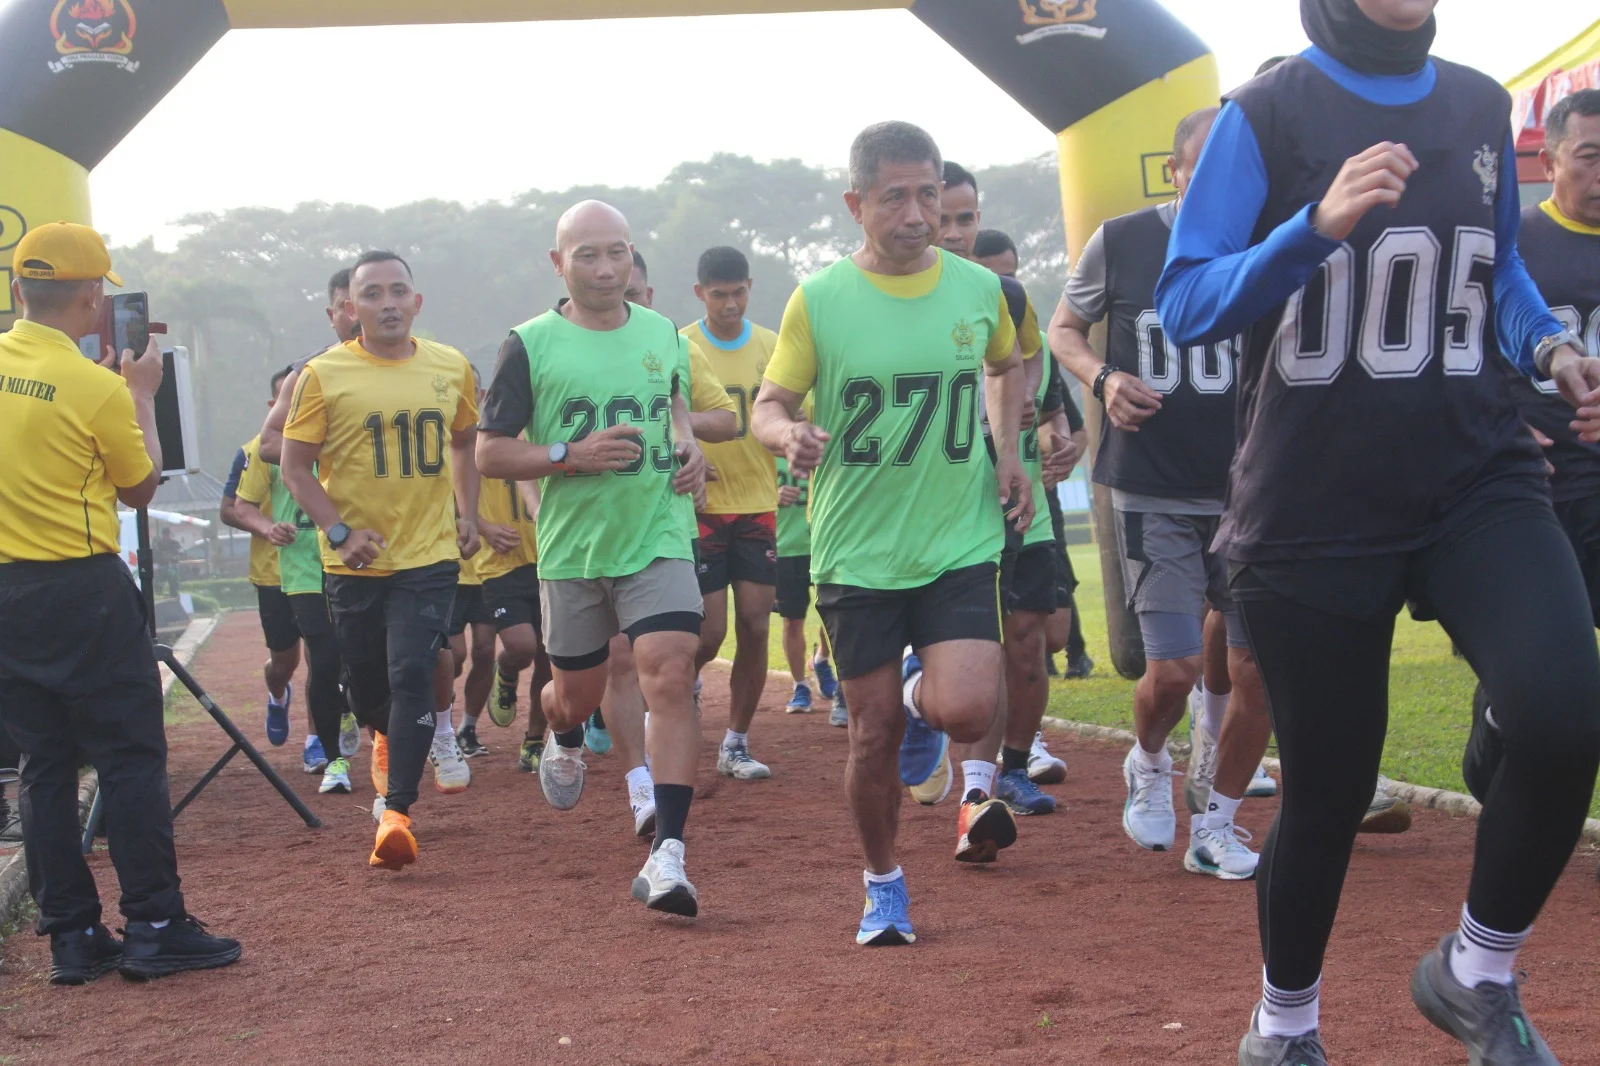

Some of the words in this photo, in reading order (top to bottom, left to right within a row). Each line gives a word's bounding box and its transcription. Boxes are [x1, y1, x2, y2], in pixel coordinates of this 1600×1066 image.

[1275, 225, 1496, 387] 005
[5, 376, 57, 402] MILITER
[840, 367, 978, 467] 270
[363, 408, 446, 479] 110
[560, 394, 674, 477] 263
